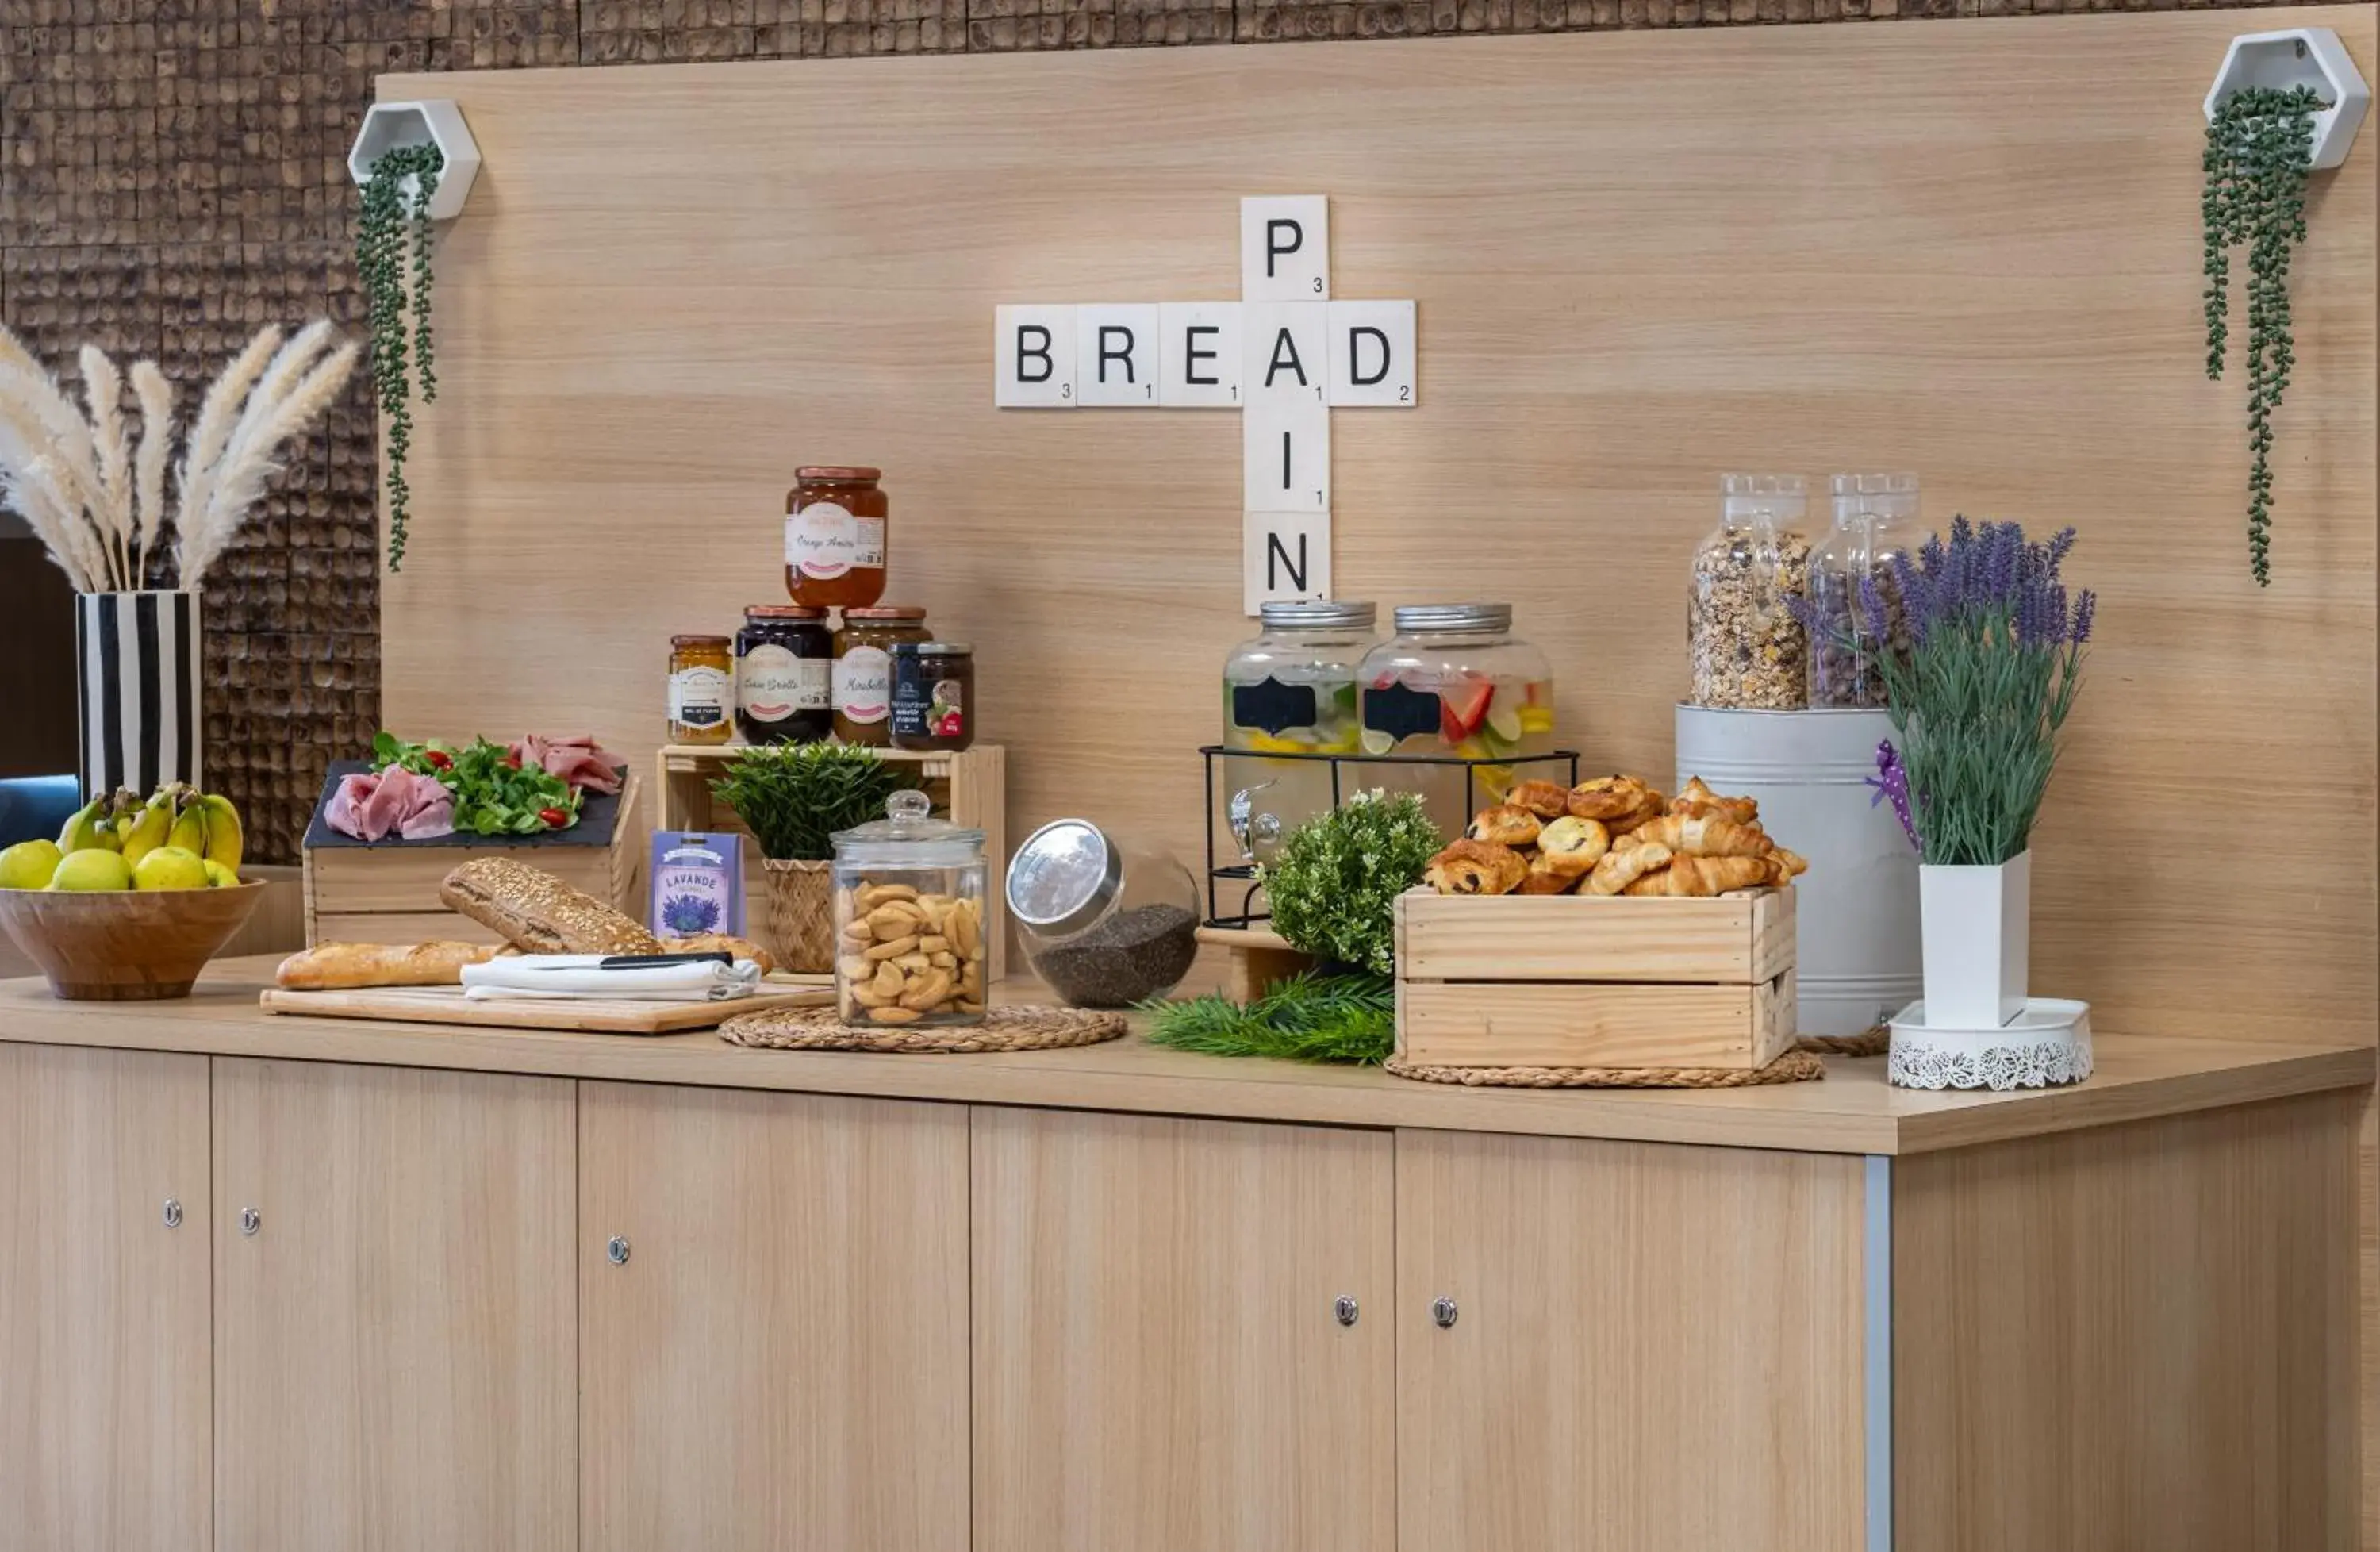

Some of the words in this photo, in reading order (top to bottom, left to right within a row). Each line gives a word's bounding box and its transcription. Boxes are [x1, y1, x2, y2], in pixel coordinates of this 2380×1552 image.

[1313, 277, 1322, 293] 3
[1016, 325, 1392, 387] BREAD
[1062, 383, 1071, 399] 3
[1145, 383, 1152, 399] 1
[1230, 385, 1238, 400] 1
[1315, 386, 1322, 401] 1
[1399, 386, 1410, 401] 2
[1265, 218, 1308, 593] PAIN
[1315, 490, 1322, 505] 1
[666, 873, 717, 889] LAVANDE
